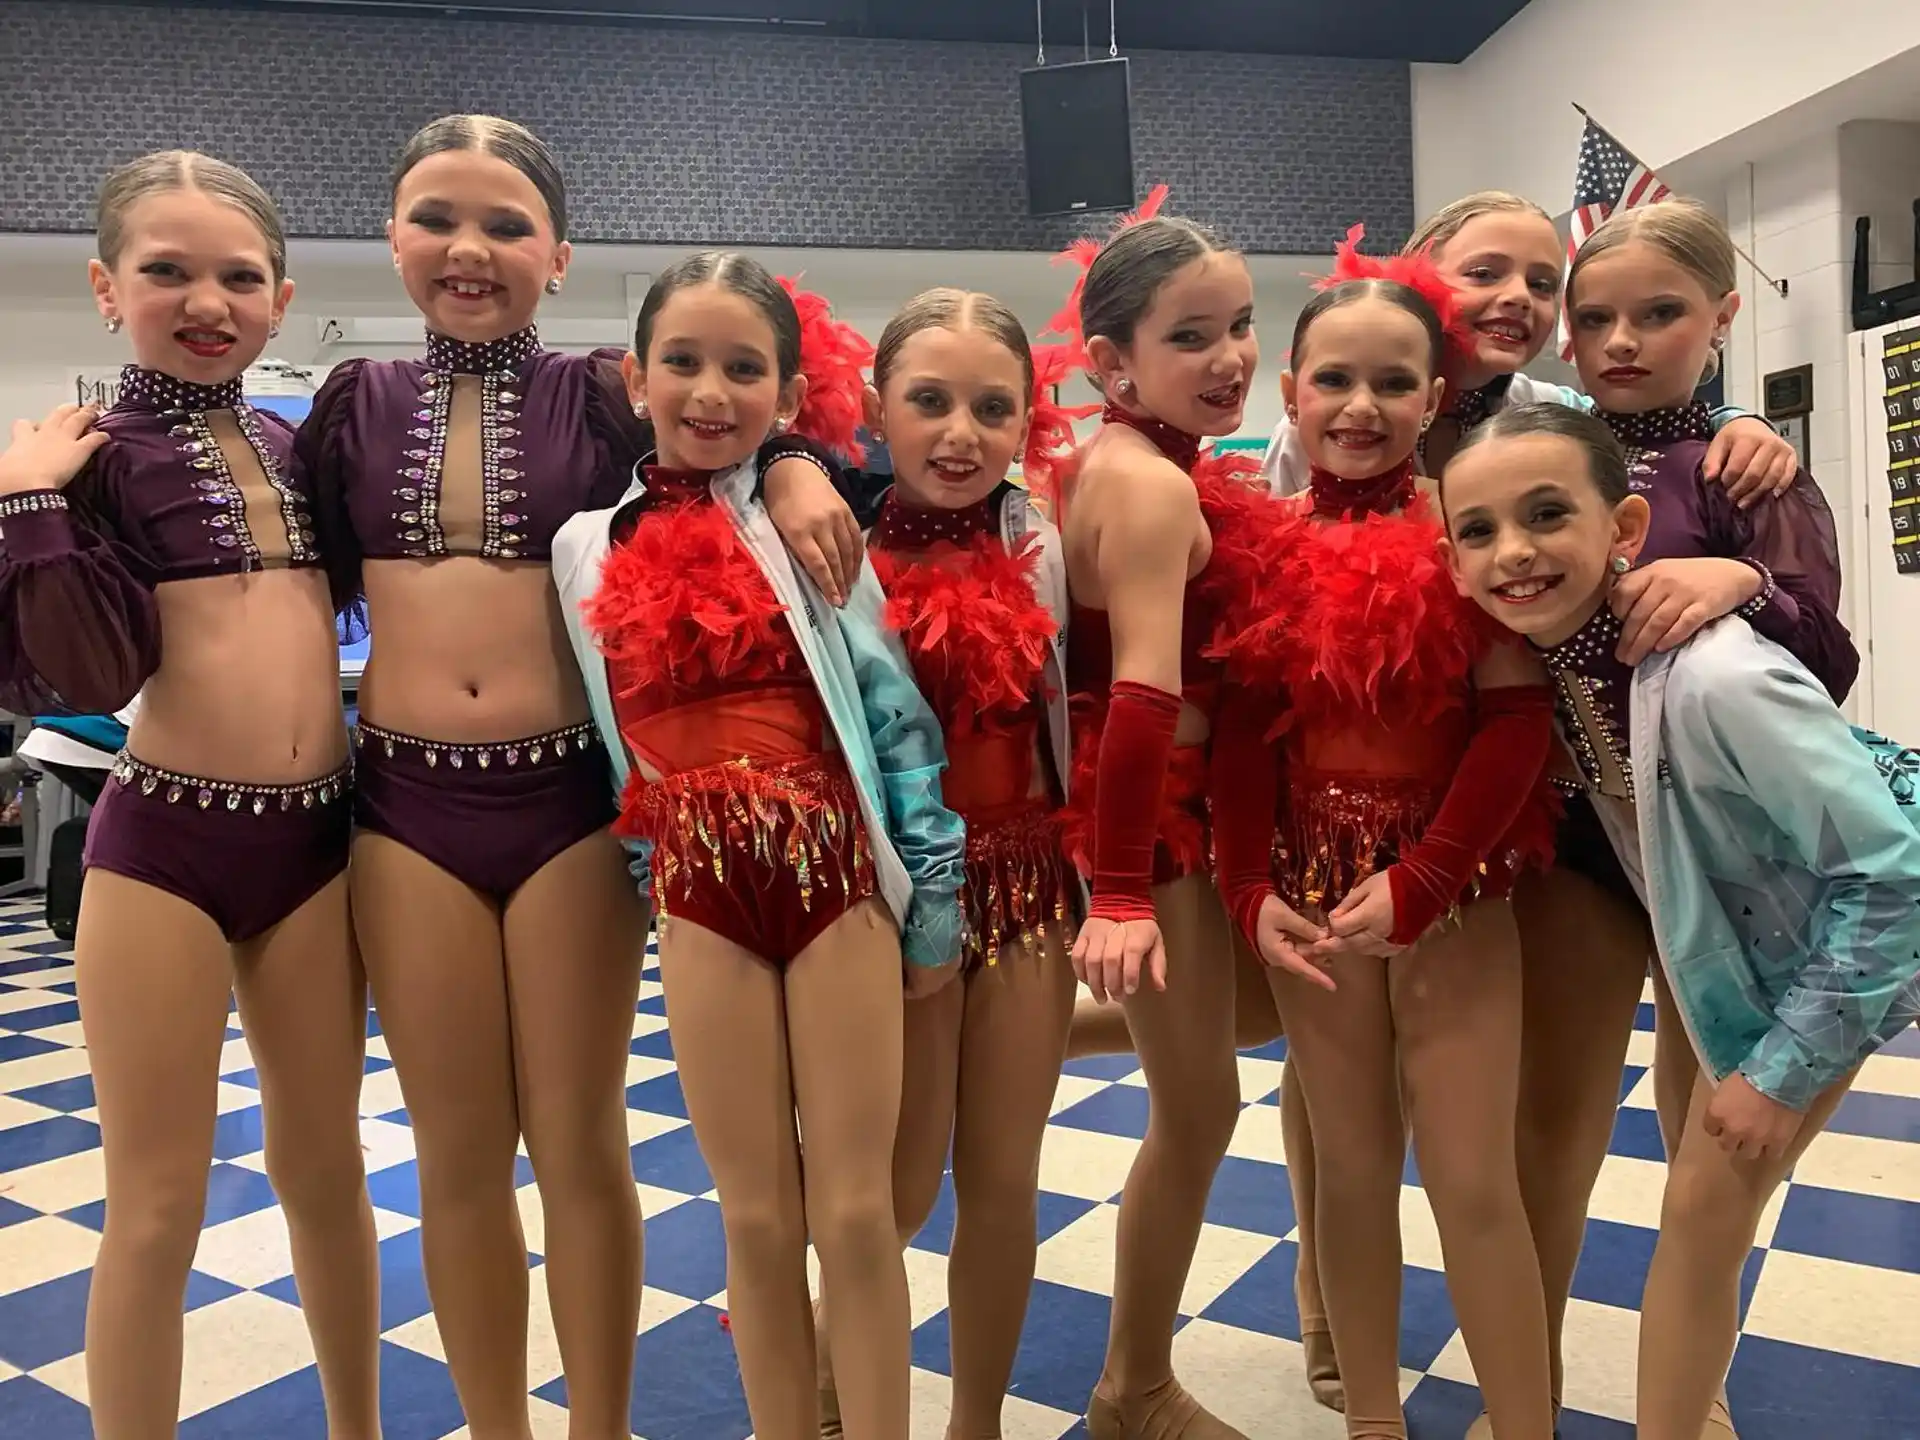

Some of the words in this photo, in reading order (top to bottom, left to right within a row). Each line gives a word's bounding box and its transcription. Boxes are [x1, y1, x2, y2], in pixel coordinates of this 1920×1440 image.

[1887, 365, 1900, 380] 01
[75, 374, 122, 410] Mu
[1888, 403, 1902, 417] 07
[1891, 439, 1904, 453] 13
[1892, 476, 1907, 491] 19
[1893, 516, 1909, 530] 25
[1896, 551, 1912, 565] 31
